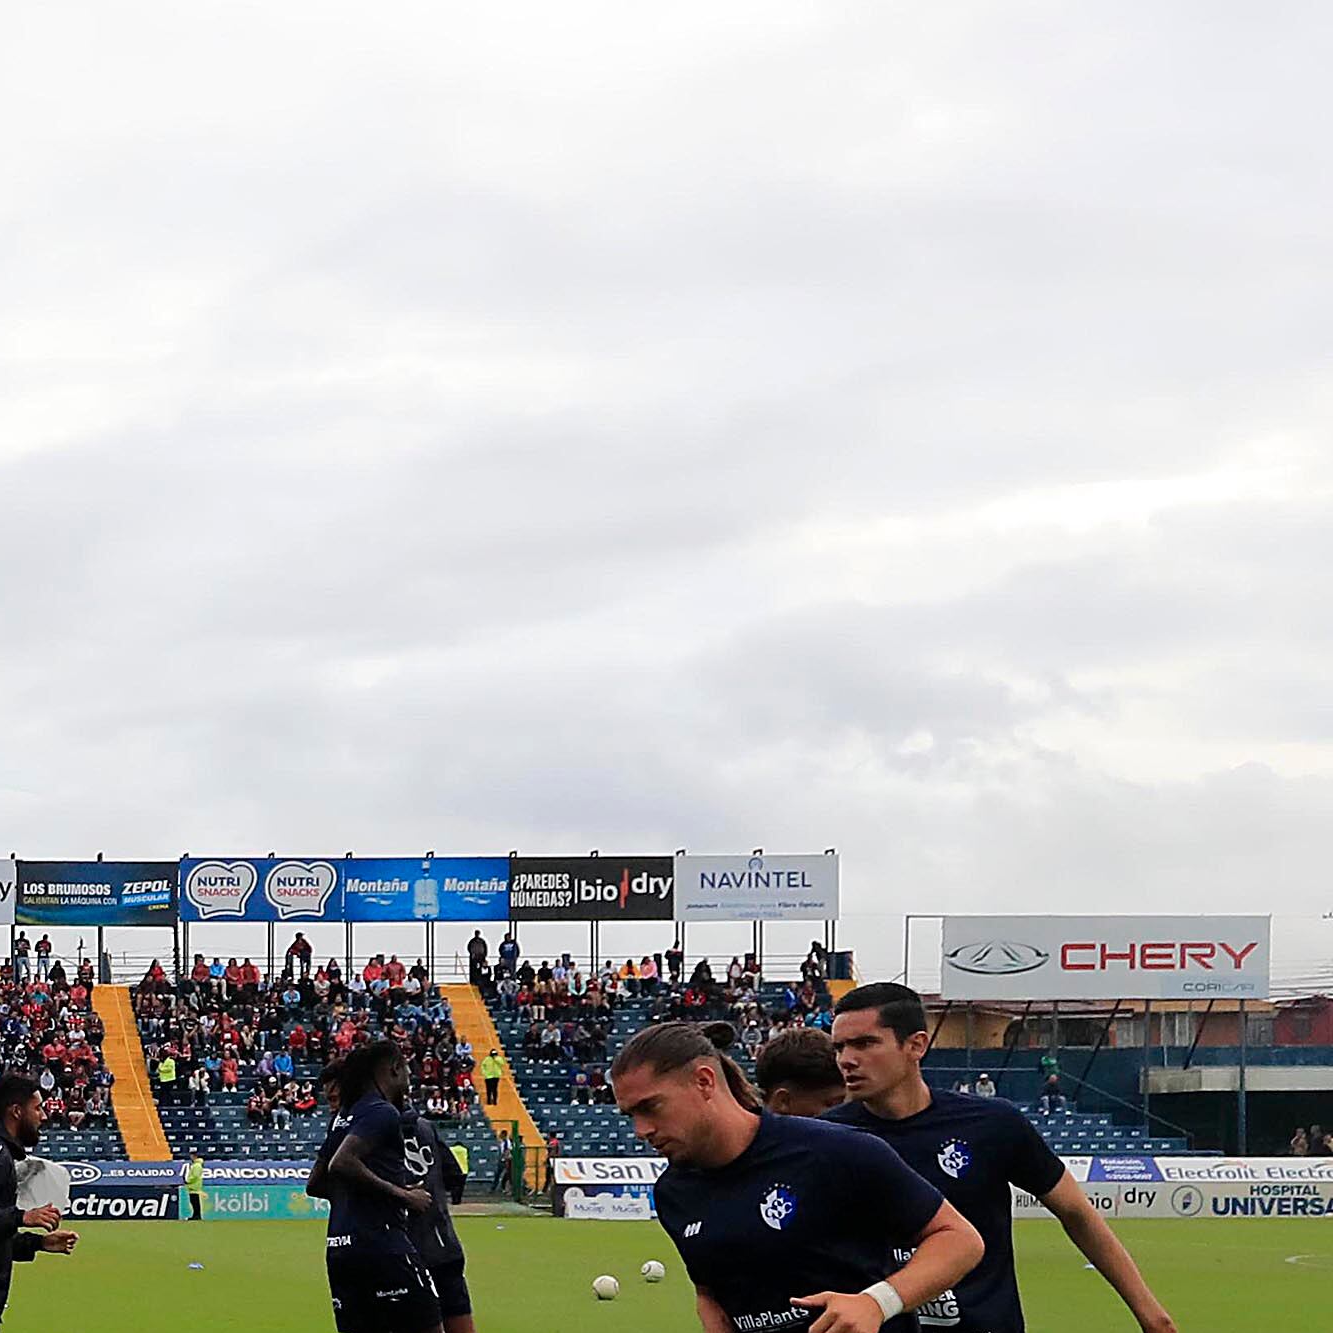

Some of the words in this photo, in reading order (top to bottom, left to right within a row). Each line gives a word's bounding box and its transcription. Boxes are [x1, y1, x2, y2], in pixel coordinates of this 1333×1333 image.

[121, 880, 171, 894] ZEPOL
[197, 876, 241, 888] NUTRI
[276, 876, 320, 888] NUTRI
[346, 878, 409, 893] Montaña
[444, 876, 507, 892] Montaña
[512, 873, 570, 891] ¿PAREDES
[581, 881, 618, 901] bio
[632, 873, 674, 900] dry
[700, 871, 812, 889] NAVINTEL
[23, 884, 45, 896] LOS
[47, 884, 111, 896] BRUMOSOS
[197, 887, 241, 898] SNACKS
[276, 887, 320, 898] SNACKS
[1060, 941, 1259, 972] CHERY
[126, 1168, 175, 1177] CALIDAD
[201, 1167, 268, 1179] BANCO
[592, 1162, 643, 1180] San
[1165, 1166, 1259, 1180] Electrolit
[1123, 1187, 1157, 1208] dry
[1249, 1184, 1320, 1196] HOSPITAL
[63, 1193, 170, 1218] ectroval
[214, 1191, 270, 1213] kölbi
[733, 1305, 810, 1331] VillaPlants
